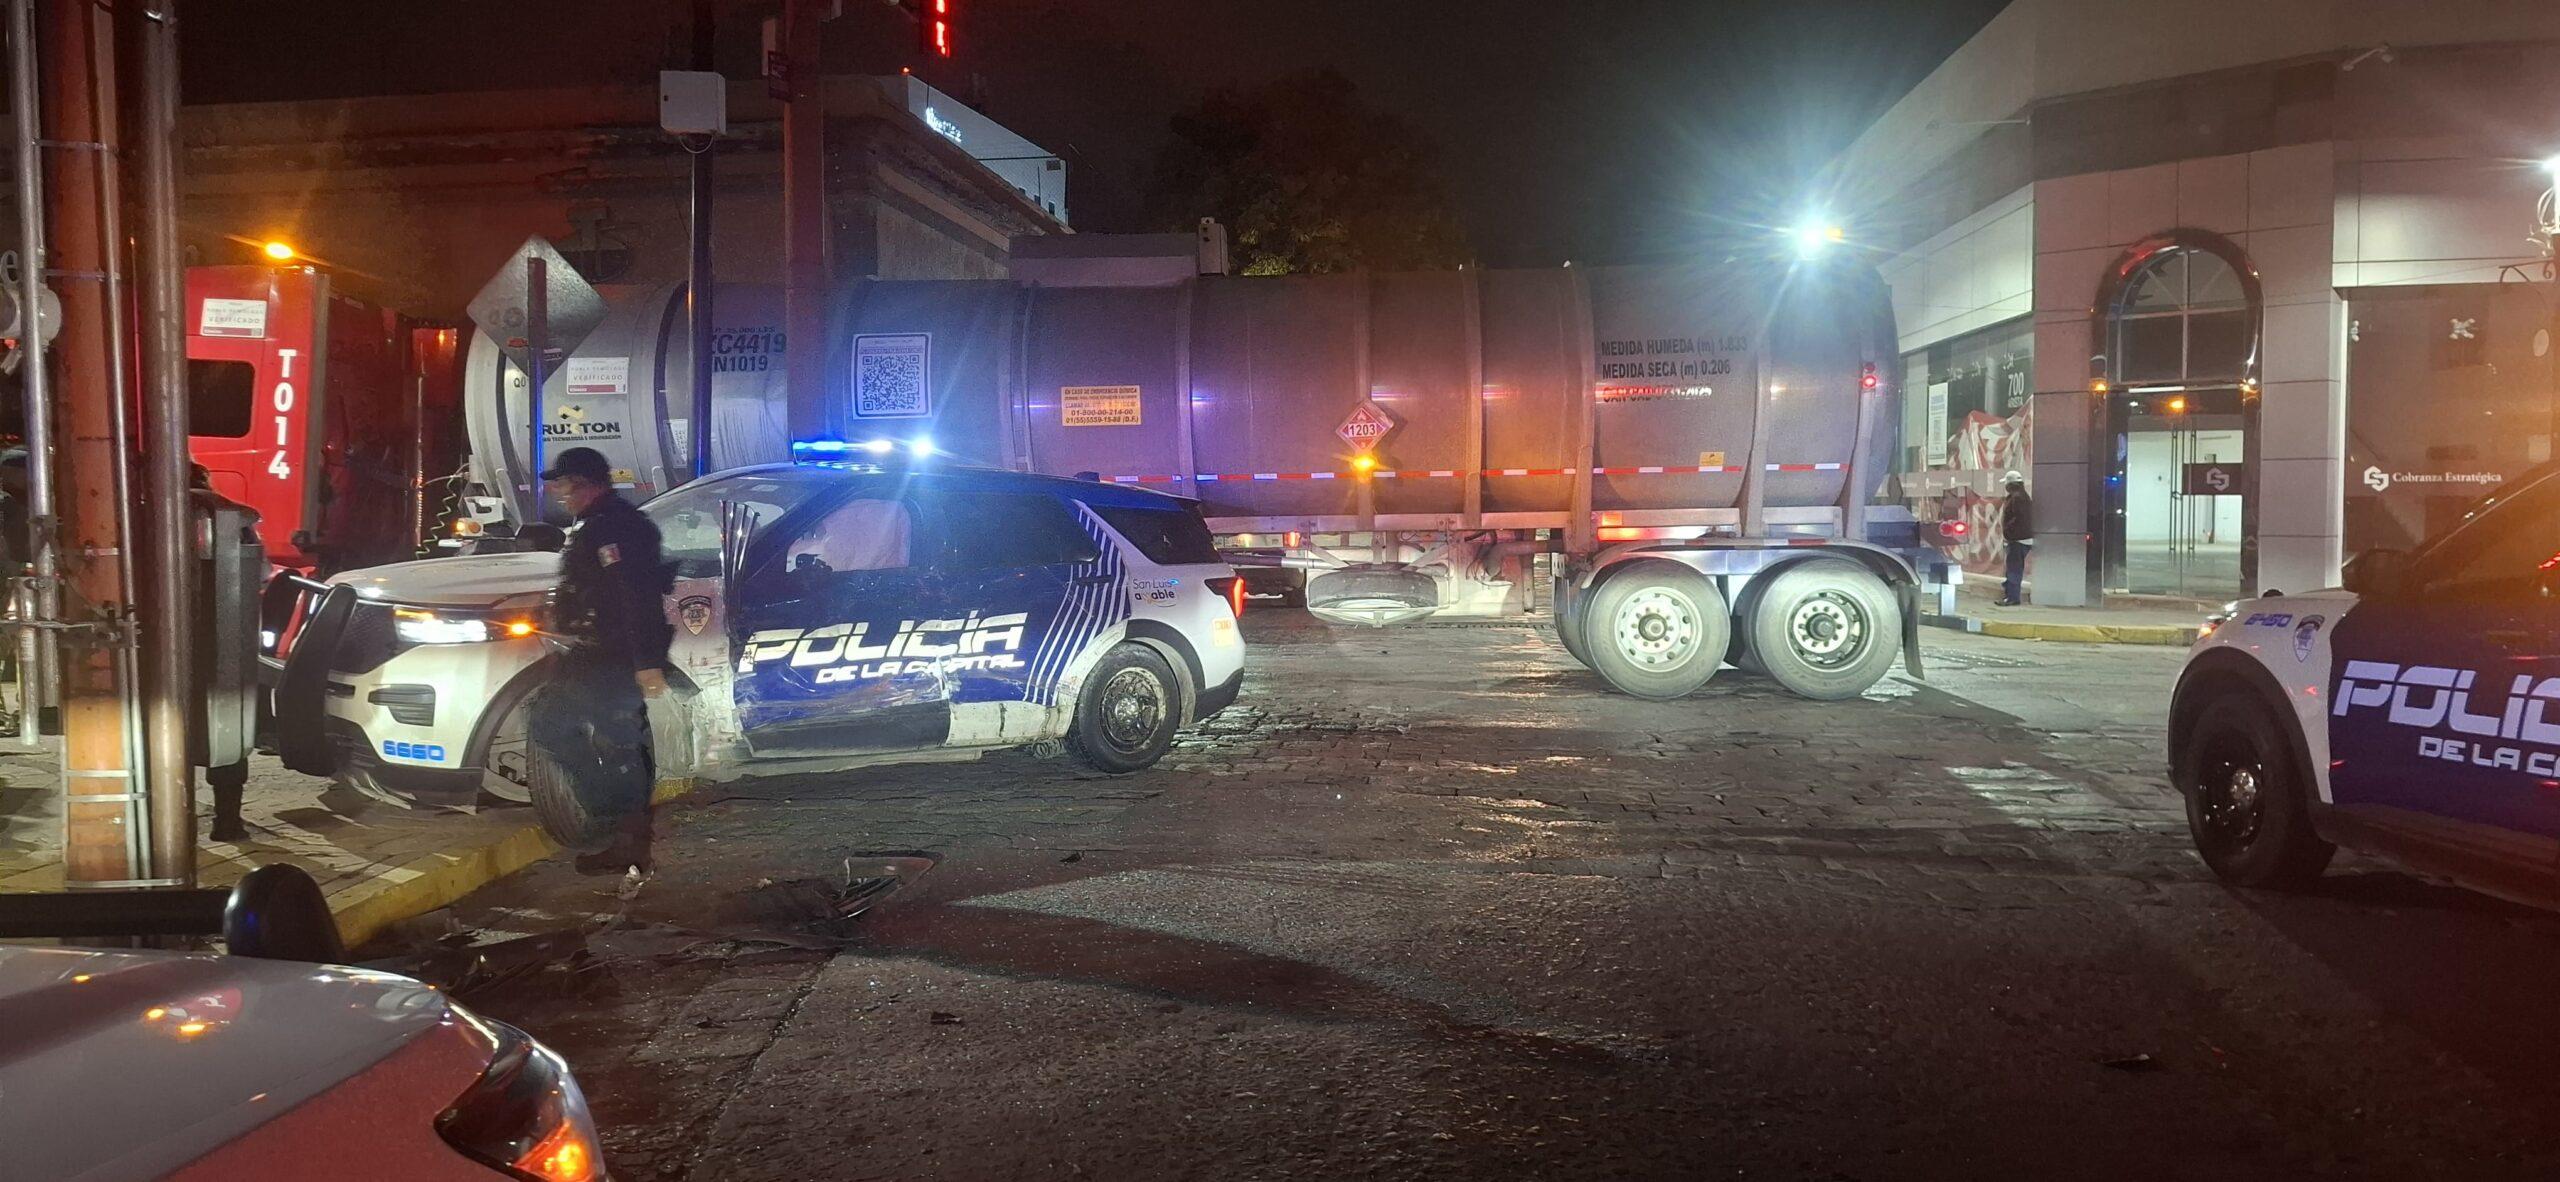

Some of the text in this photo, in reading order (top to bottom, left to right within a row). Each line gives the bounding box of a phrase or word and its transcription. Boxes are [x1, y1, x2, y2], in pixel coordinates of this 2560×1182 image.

[1601, 340, 1643, 356] MEDIDA
[1647, 337, 1694, 355] HUMEDA
[1697, 338, 1714, 355] (m)
[1602, 359, 1731, 379] MEDIDA SECA (m) 0.206
[2008, 372, 2024, 396] 700
[268, 349, 297, 480] T014
[526, 421, 621, 435] RUXTON
[1350, 424, 1376, 436] 1203
[2392, 471, 2502, 484] Cobranza Estratégica
[1133, 579, 1150, 589] San
[815, 666, 858, 683] DE
[861, 663, 902, 678] LA
[2418, 736, 2466, 762] DE
[2471, 743, 2520, 771] LA
